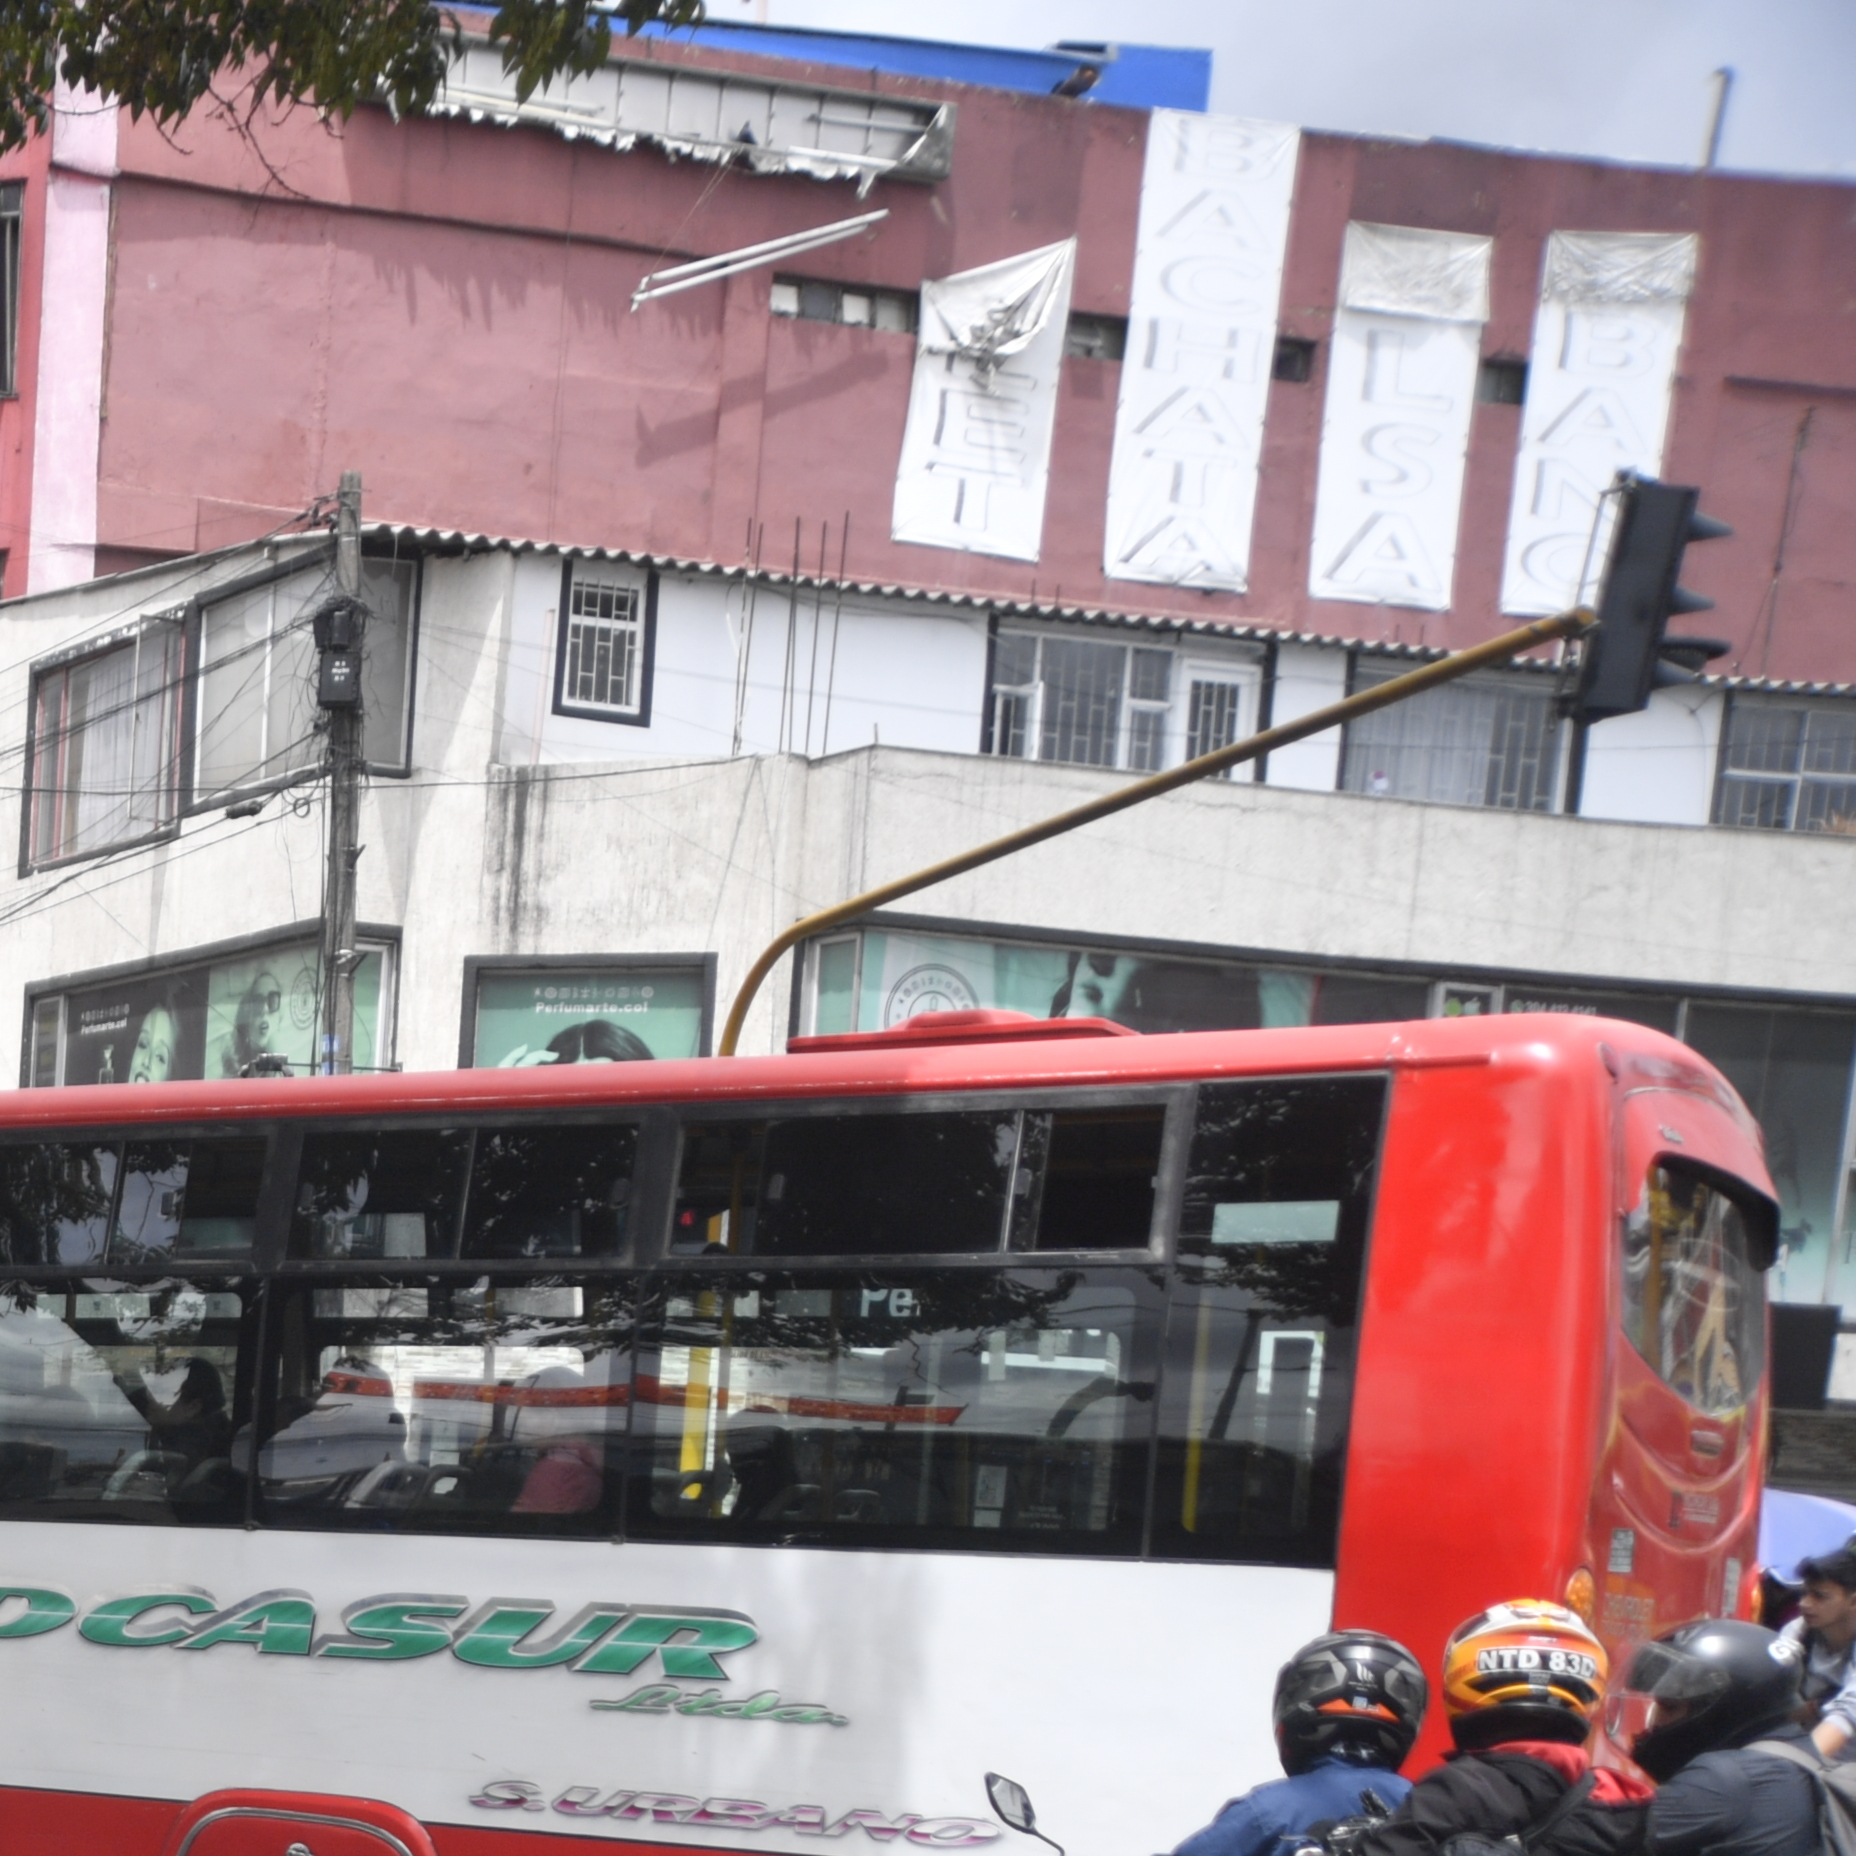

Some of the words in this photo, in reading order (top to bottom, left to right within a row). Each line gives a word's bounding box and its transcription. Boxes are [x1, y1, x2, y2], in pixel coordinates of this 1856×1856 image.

[1120, 116, 1276, 577] BACHATA
[1322, 328, 1454, 596] LSA
[1478, 1649, 1541, 1671] NTD
[1548, 1650, 1596, 1680] 83D
